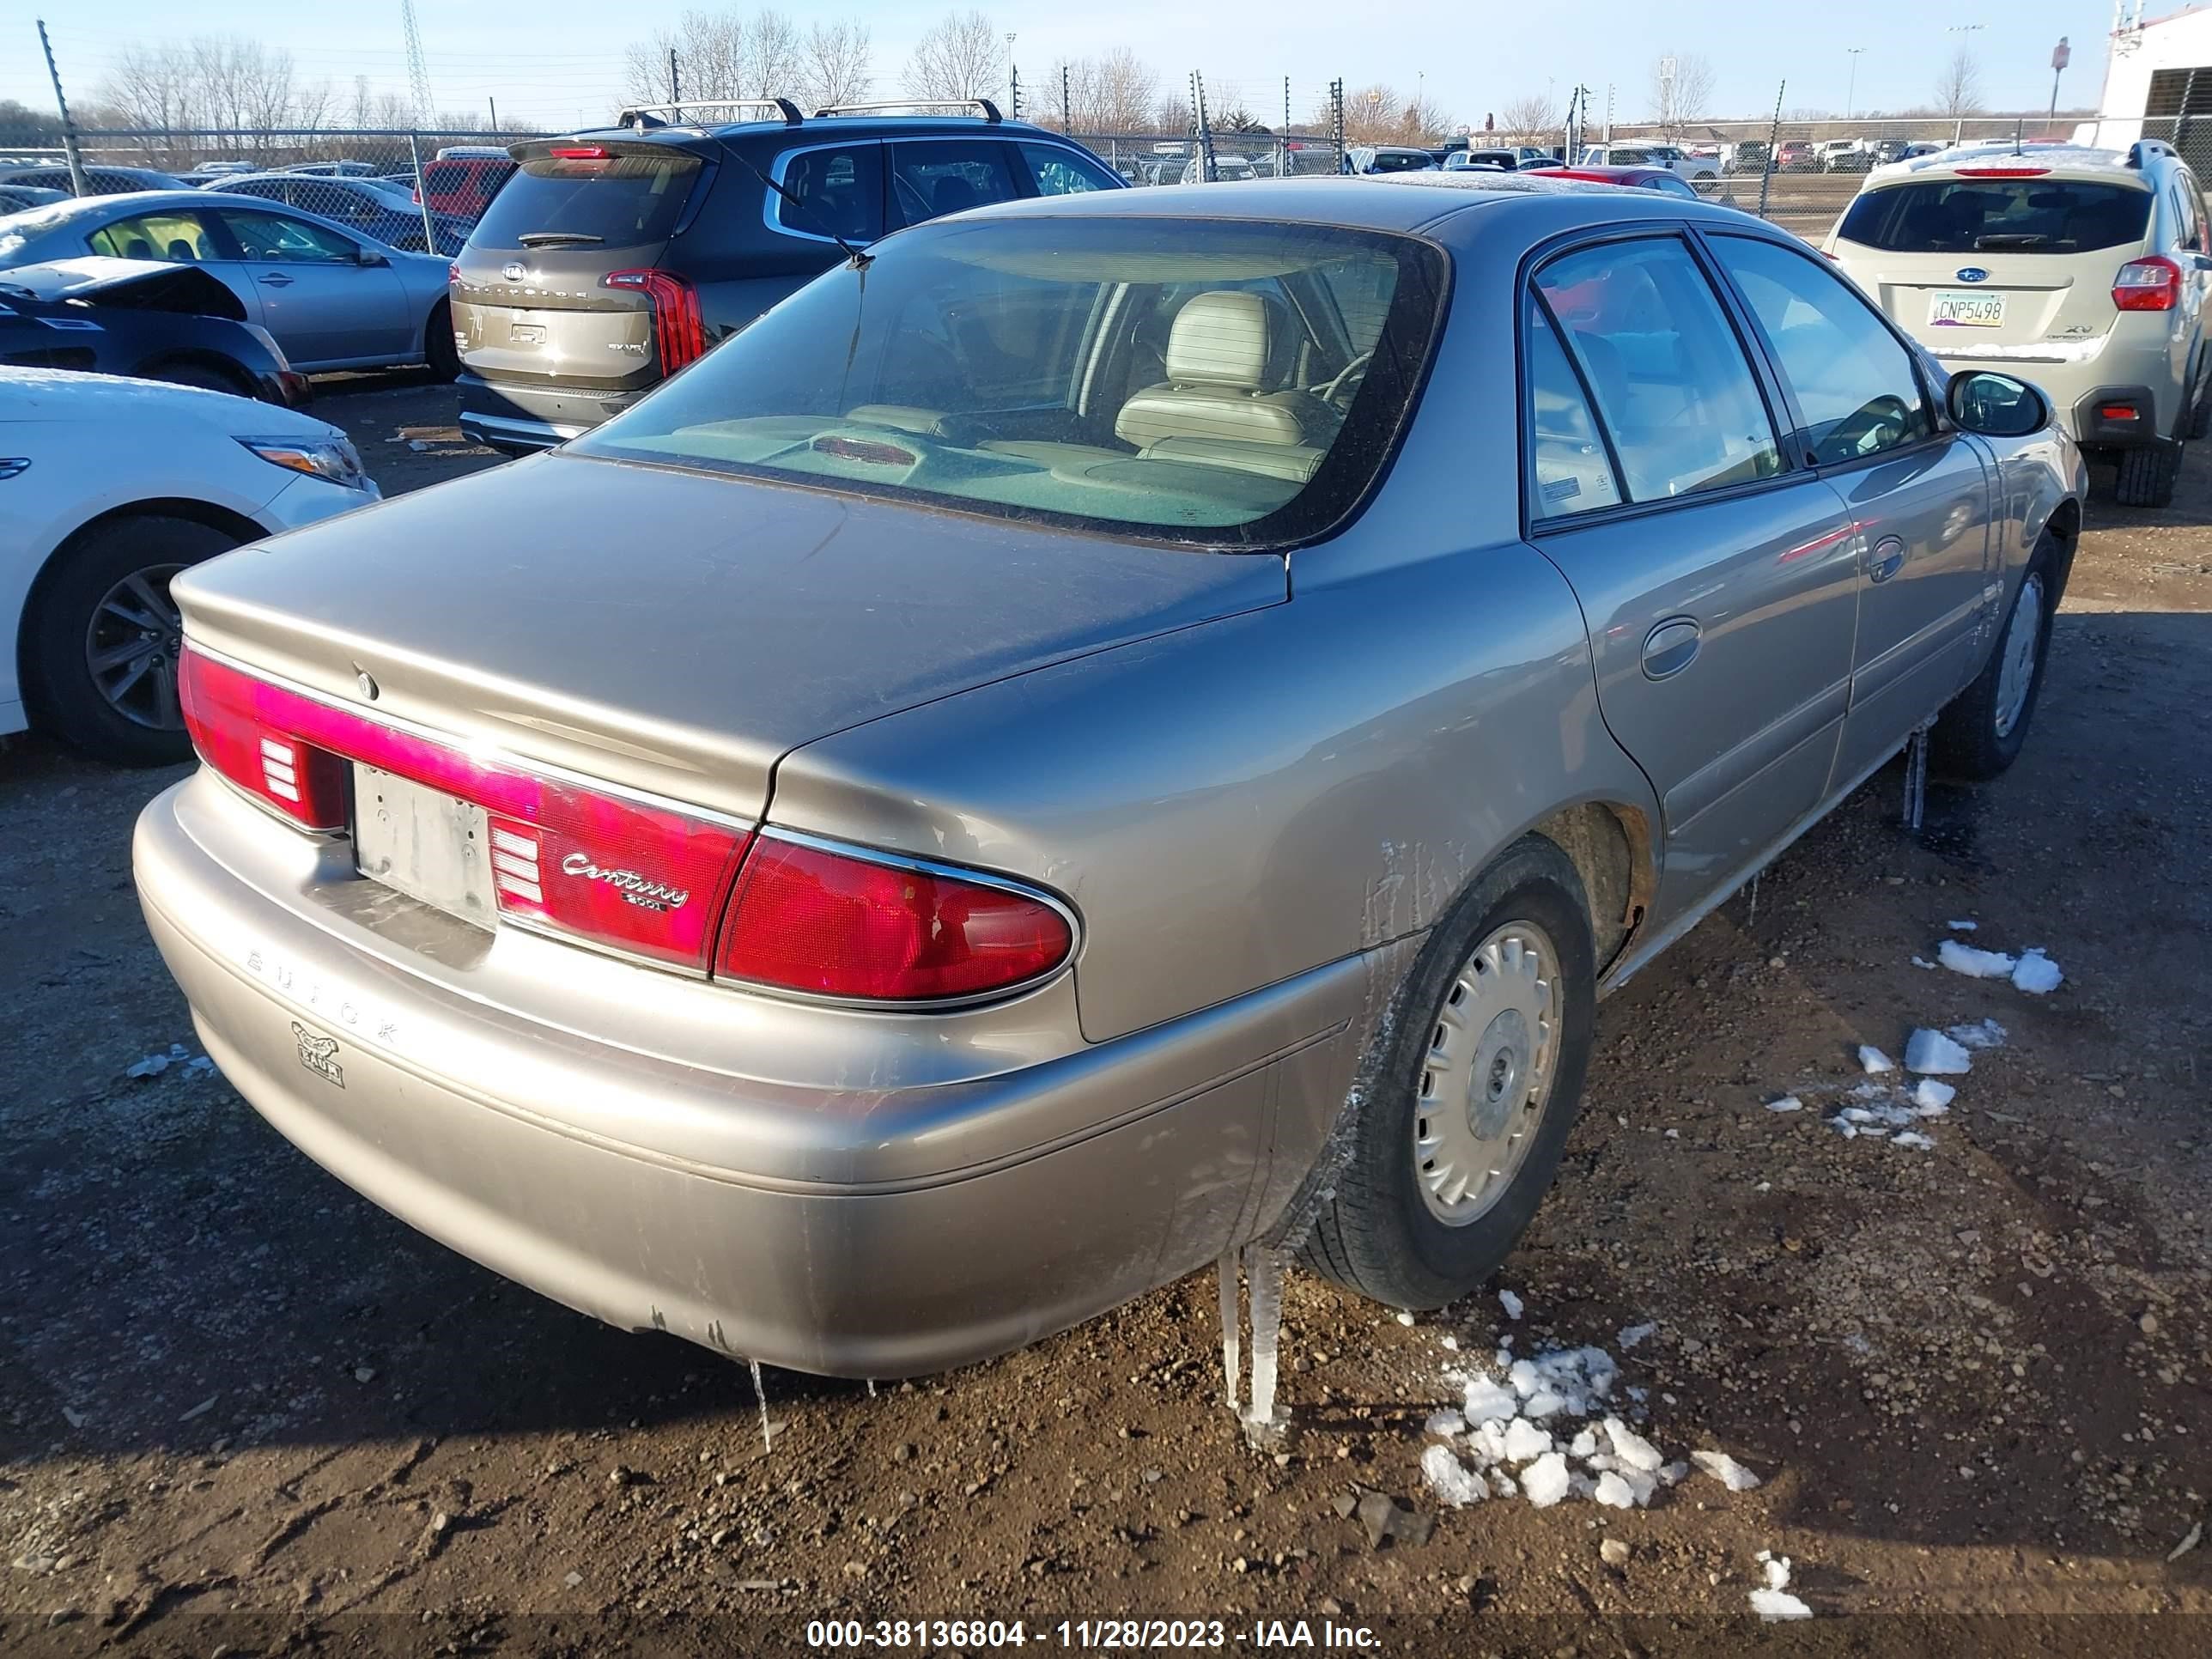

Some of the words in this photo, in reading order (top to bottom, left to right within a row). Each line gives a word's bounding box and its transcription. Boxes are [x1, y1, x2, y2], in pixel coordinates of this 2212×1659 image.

[504, 267, 523, 279] KIA
[1939, 301, 2002, 320] CNP5498
[562, 852, 689, 908] Century
[627, 894, 662, 911] 2001
[246, 948, 398, 1043] BUICK
